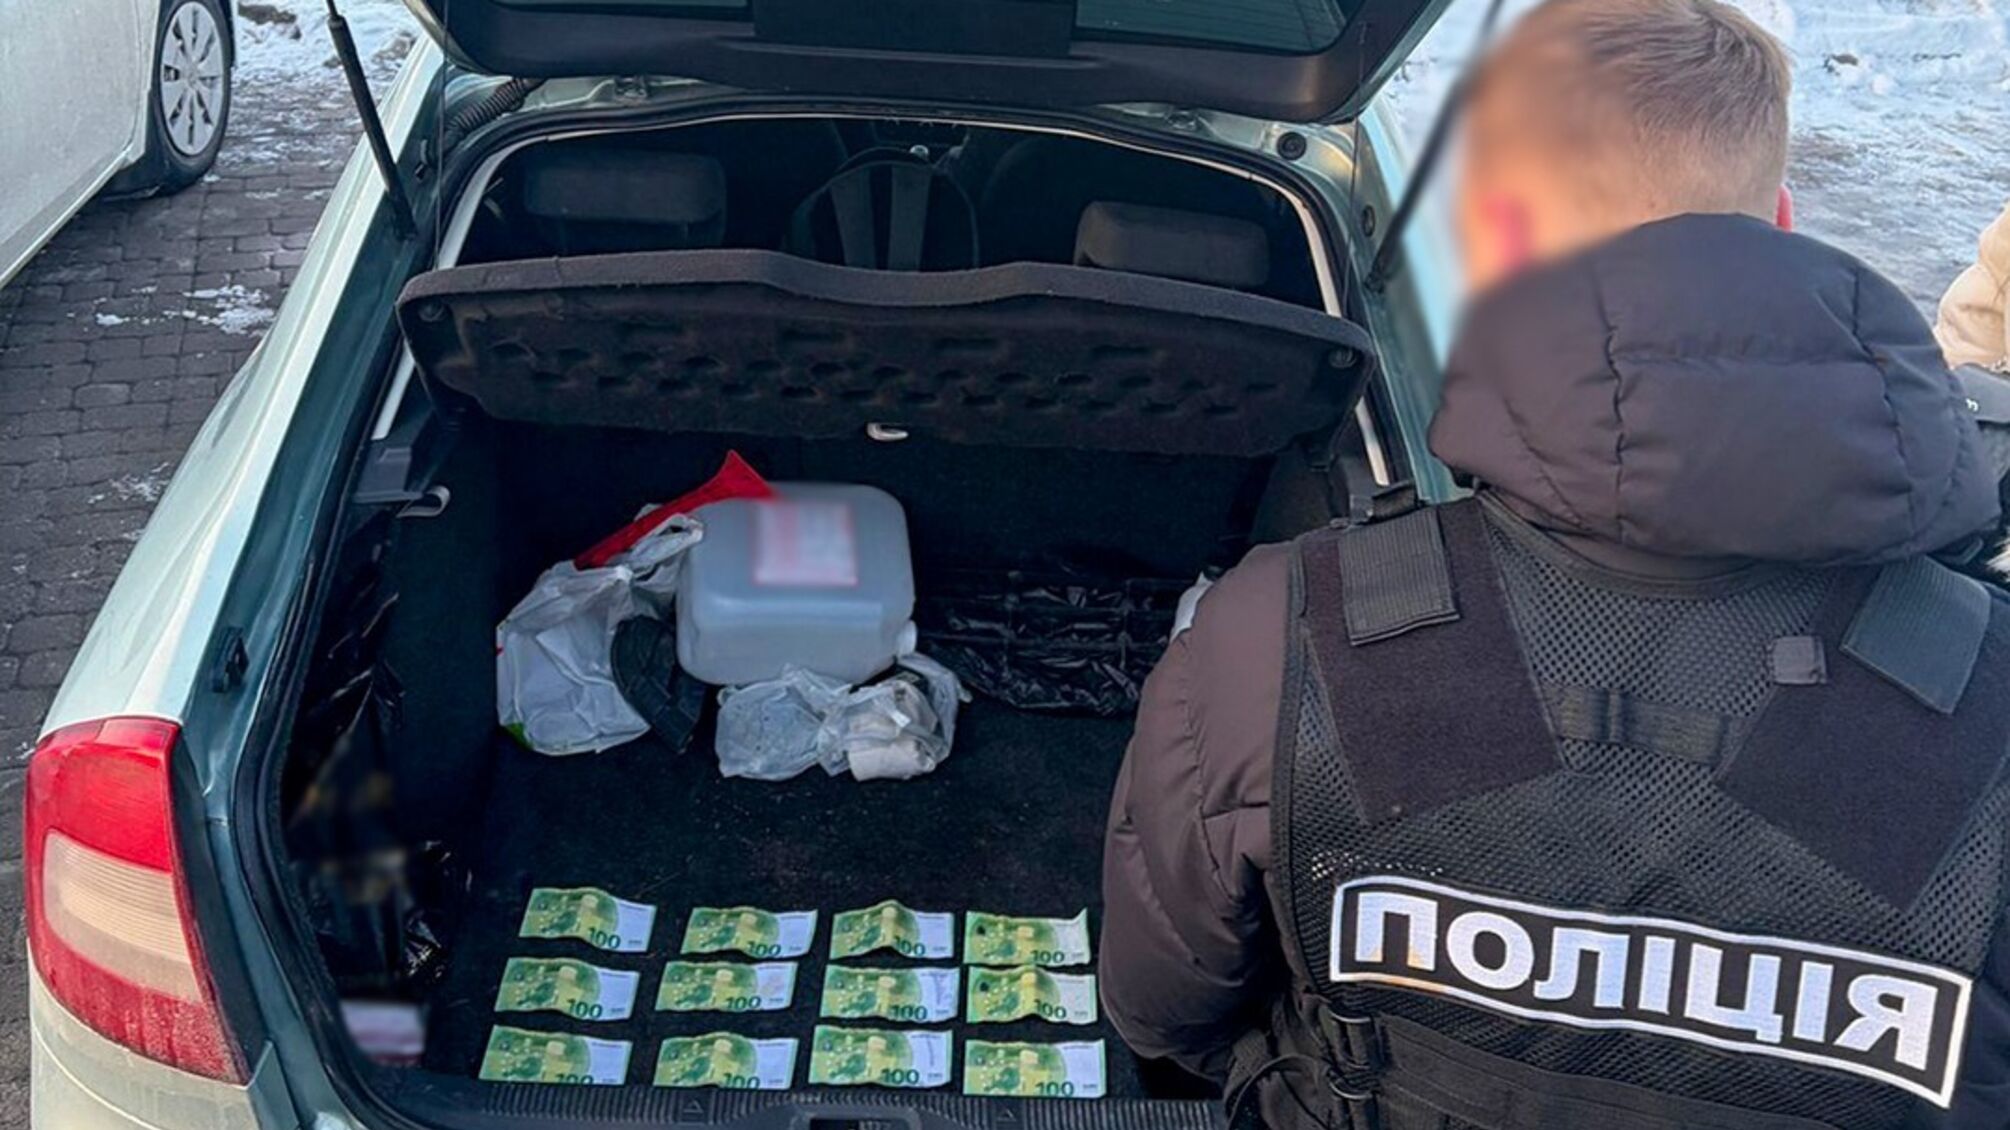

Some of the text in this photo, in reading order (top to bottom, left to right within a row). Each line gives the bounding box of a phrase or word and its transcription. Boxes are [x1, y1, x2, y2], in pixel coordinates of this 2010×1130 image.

[588, 927, 621, 949] 100
[747, 940, 781, 957] 100
[1031, 950, 1065, 963] 100
[1354, 891, 1938, 1071] ПОЛІЦІЯ
[566, 998, 603, 1019] 100
[726, 996, 761, 1010] 100
[1035, 999, 1066, 1019] 100
[891, 1004, 928, 1020] 100
[882, 1068, 919, 1085] 100
[1036, 1081, 1075, 1097] 100
